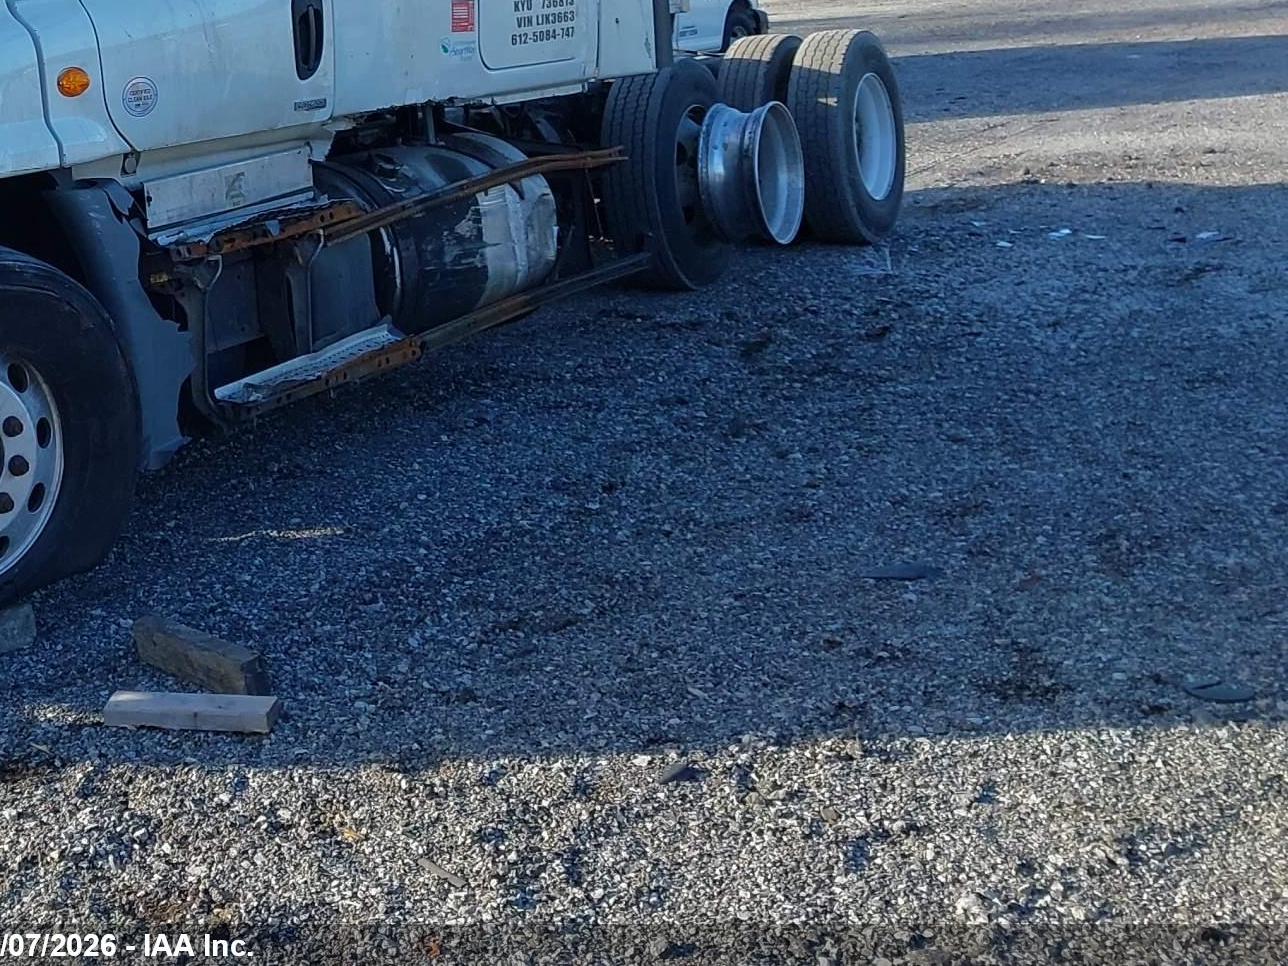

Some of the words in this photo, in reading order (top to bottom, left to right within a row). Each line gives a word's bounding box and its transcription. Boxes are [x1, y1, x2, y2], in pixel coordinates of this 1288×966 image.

[514, 0, 533, 12] KYU
[517, 15, 533, 28] VIN
[511, 27, 575, 46] 612-5084-747
